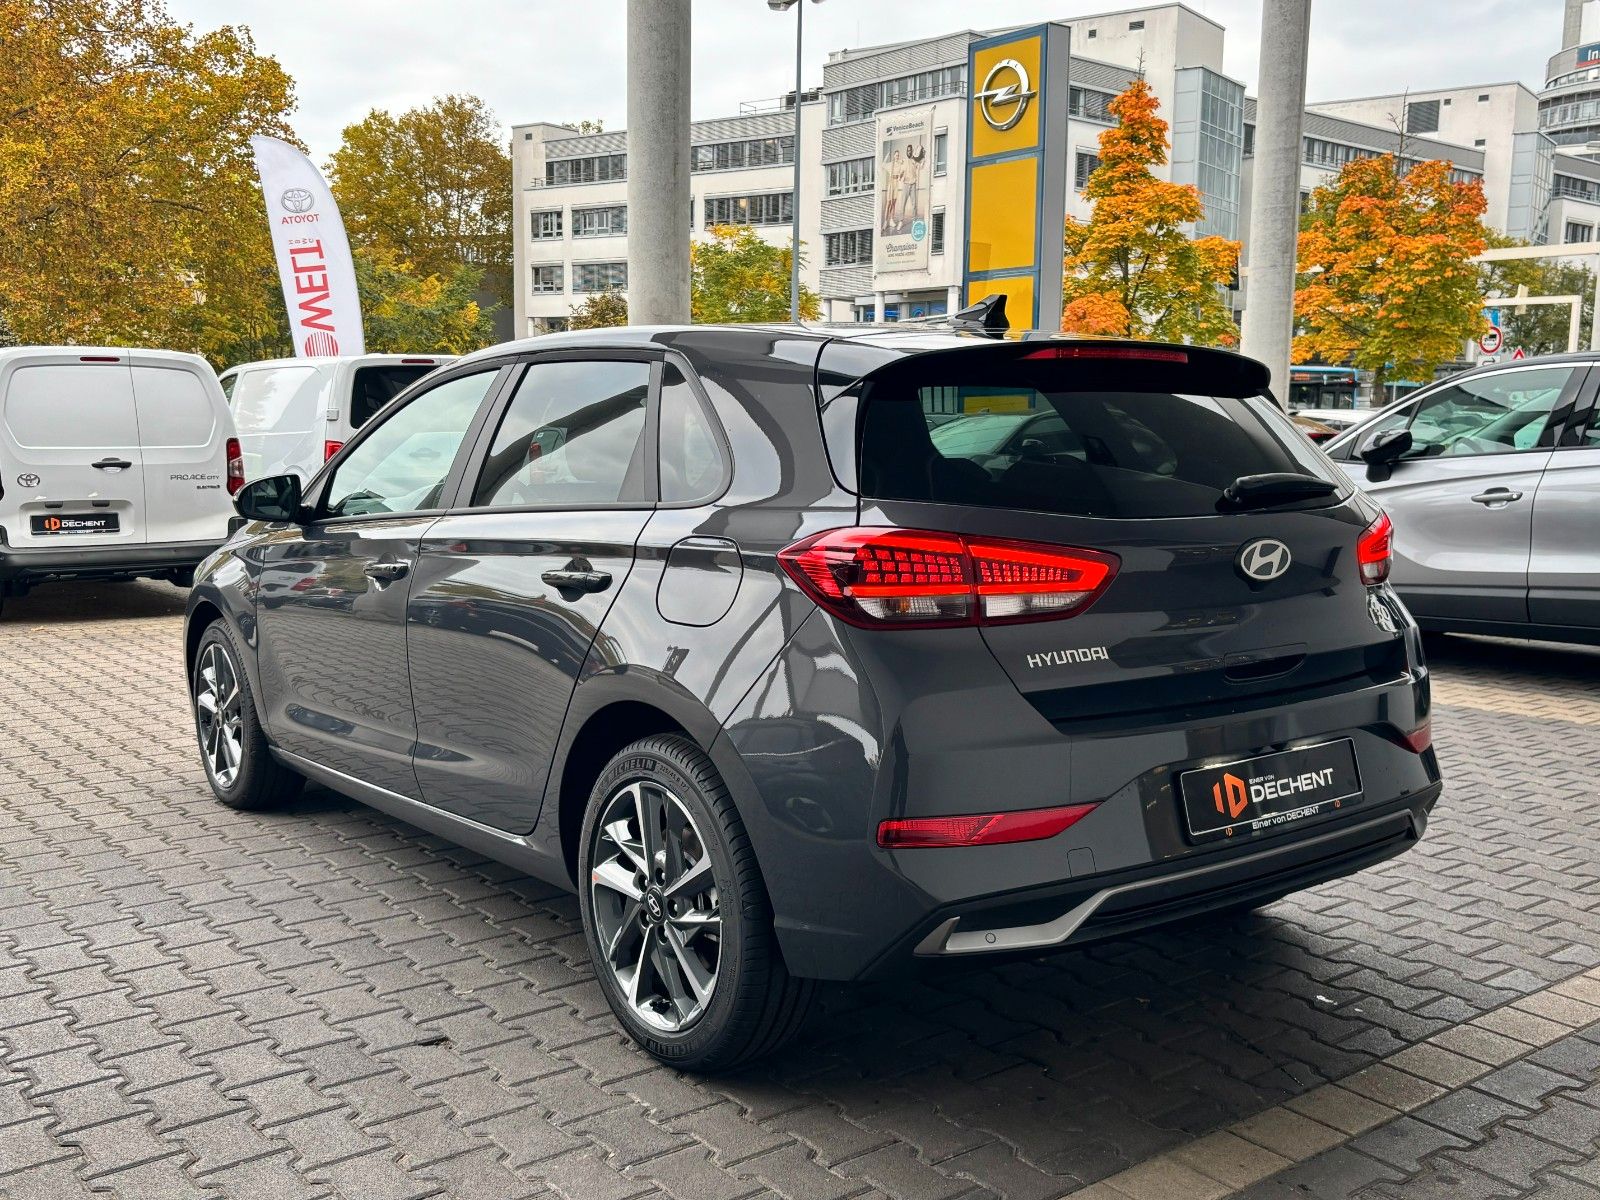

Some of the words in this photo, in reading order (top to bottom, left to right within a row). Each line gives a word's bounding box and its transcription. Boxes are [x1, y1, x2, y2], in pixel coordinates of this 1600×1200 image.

[61, 520, 106, 528] DECHENT
[1026, 646, 1110, 669] HYUNDAI
[607, 758, 654, 783] MICHELIN
[1249, 767, 1334, 803] DECHENT
[1251, 819, 1272, 830] Einer
[1271, 815, 1287, 825] von
[1286, 805, 1320, 821] DECHENT
